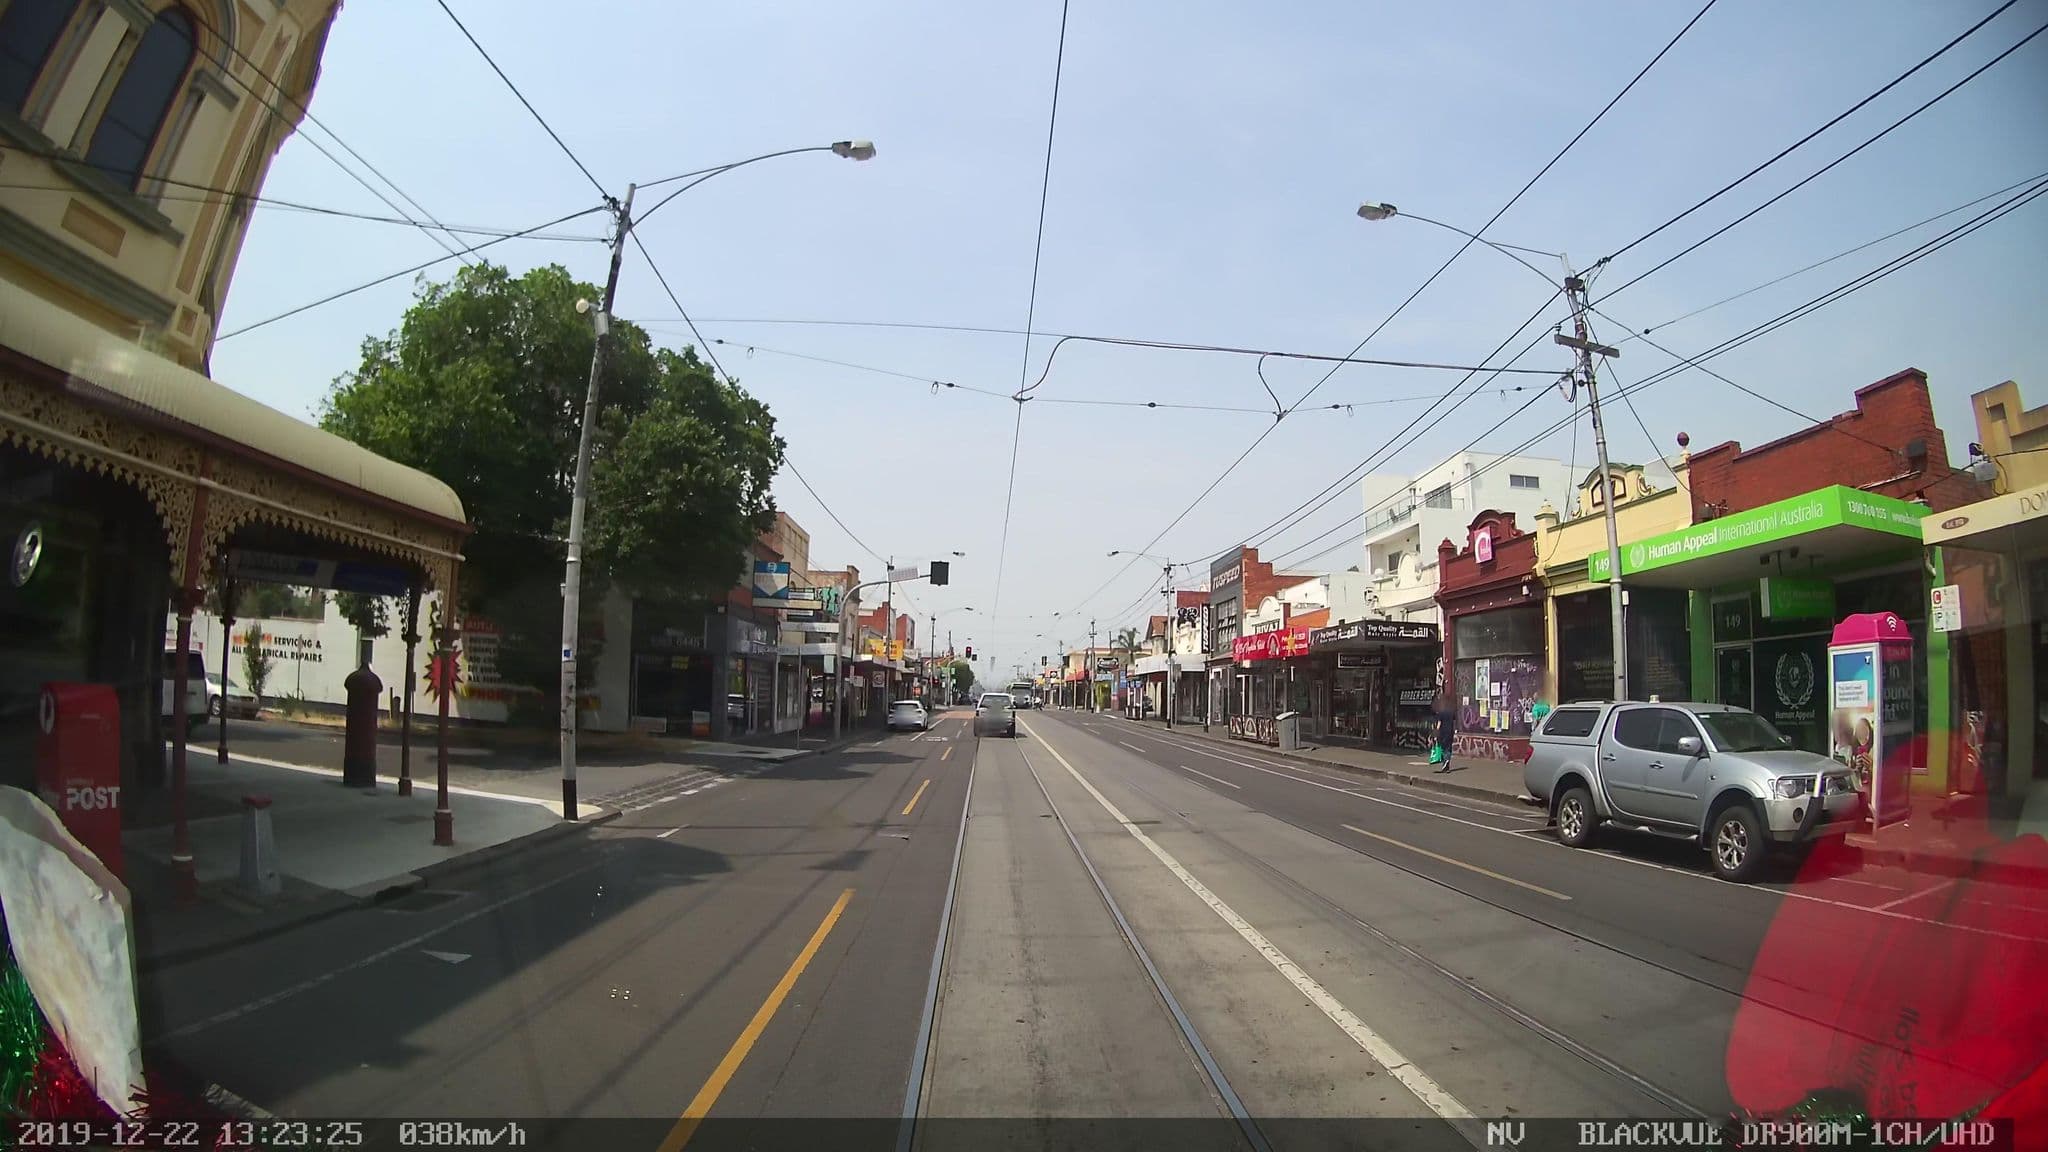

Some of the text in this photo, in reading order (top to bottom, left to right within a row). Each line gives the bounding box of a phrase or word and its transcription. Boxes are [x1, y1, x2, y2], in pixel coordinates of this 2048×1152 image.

[1875, 507, 1887, 520] 155
[1648, 500, 1825, 560] Human Appeal International Australia
[1595, 557, 1611, 574] 149
[1367, 624, 1397, 633] Top Quality
[1725, 615, 1741, 629] 149
[273, 636, 313, 649] SERVICNG
[315, 640, 322, 649] &
[1775, 709, 1815, 721] Human Appeal
[66, 786, 121, 811] POST
